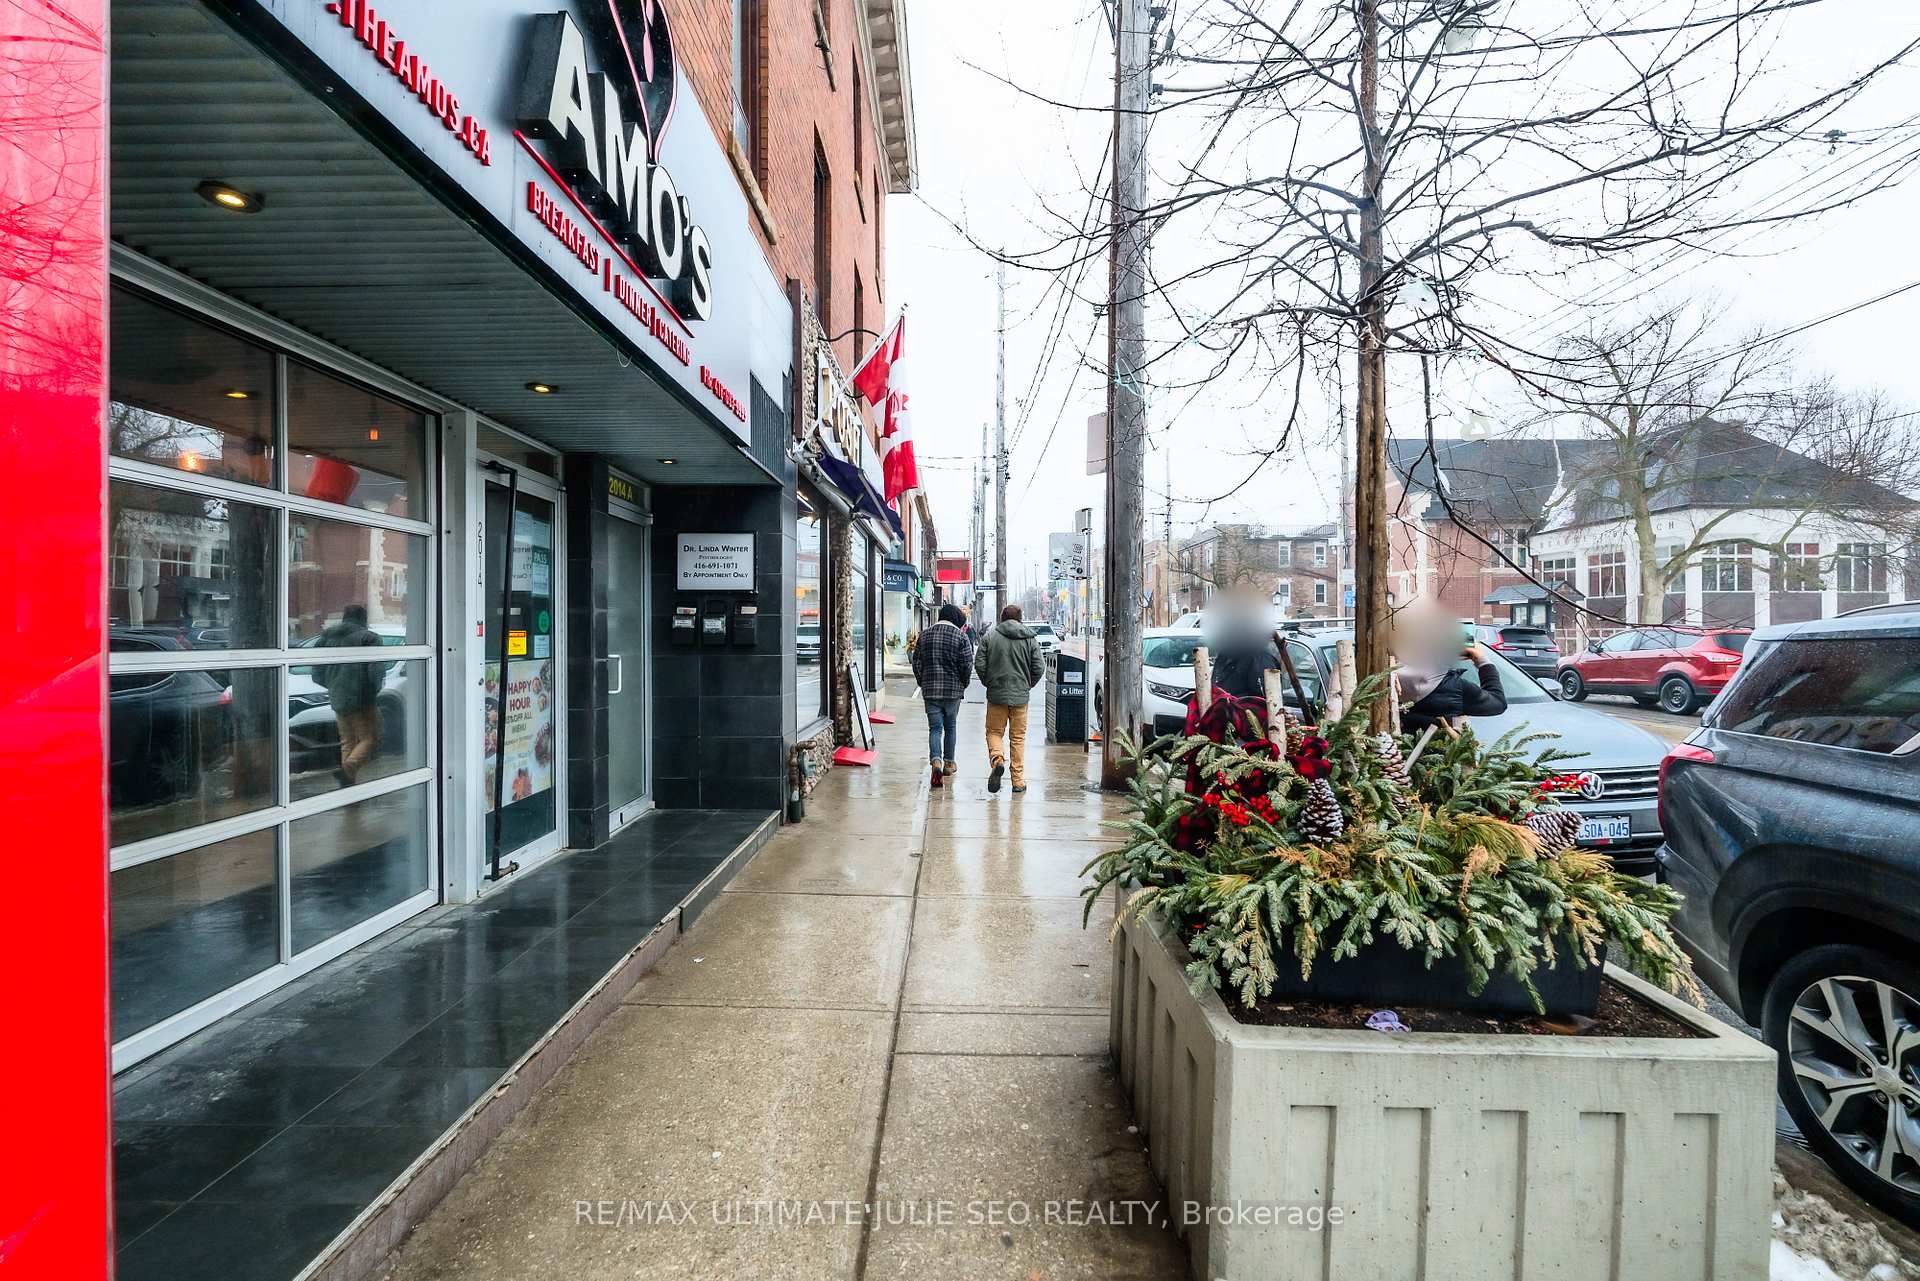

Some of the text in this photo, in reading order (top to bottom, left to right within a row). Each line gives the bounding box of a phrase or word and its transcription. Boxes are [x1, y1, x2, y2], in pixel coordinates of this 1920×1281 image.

[528, 181, 692, 366] BREAKFAST DINNER CATERING
[507, 680, 531, 695] HAPPY
[1069, 687, 1084, 695] Litter
[509, 697, 531, 711] HOUR
[1609, 822, 1629, 837] 045
